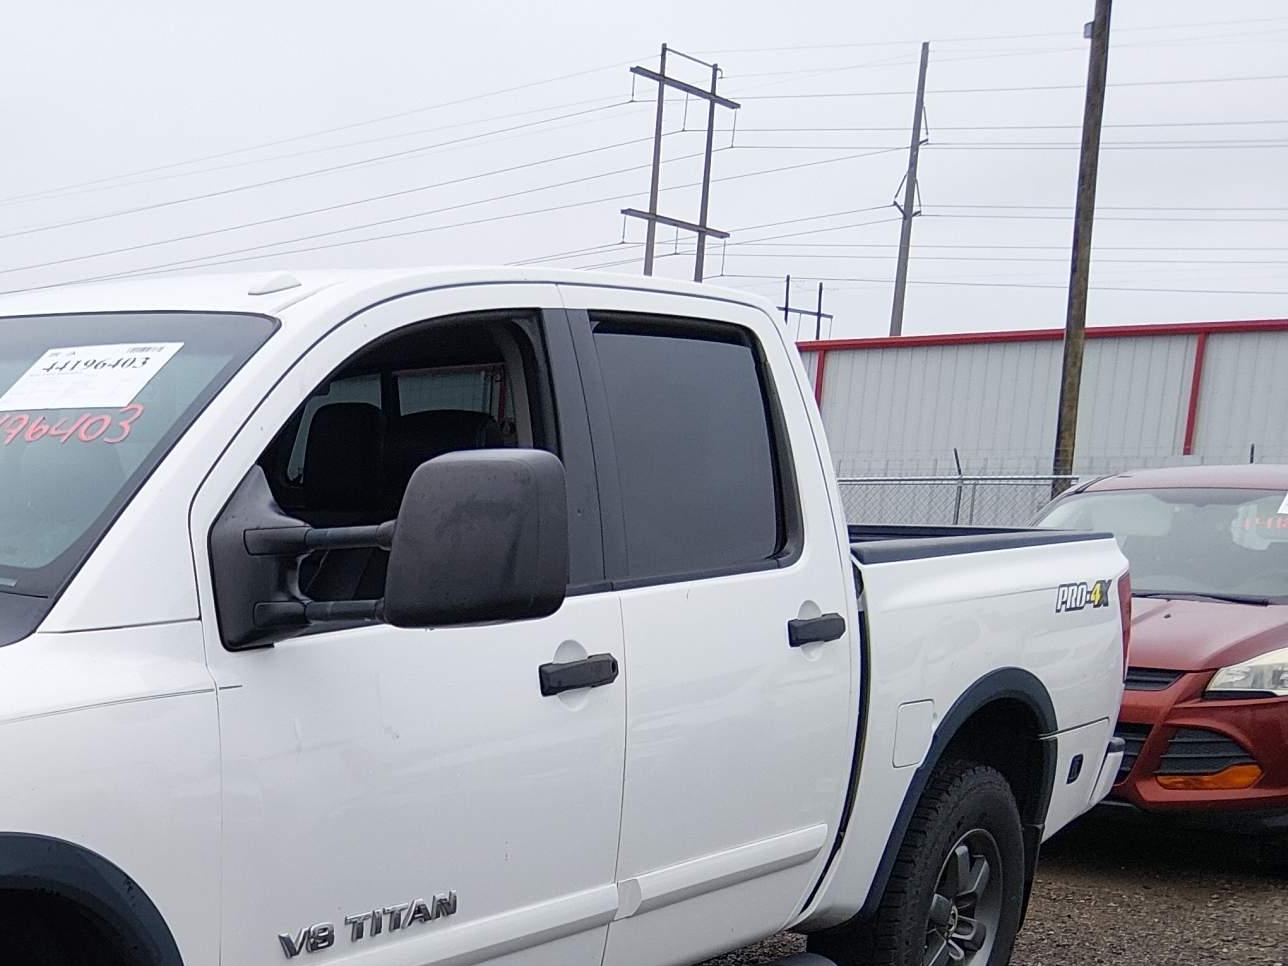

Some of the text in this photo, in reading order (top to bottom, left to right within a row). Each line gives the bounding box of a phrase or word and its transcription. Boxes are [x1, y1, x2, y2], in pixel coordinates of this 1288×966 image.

[41, 356, 151, 373] 44196403
[1055, 579, 1113, 613] PRO-4X
[278, 888, 458, 959] V8 TITAN
